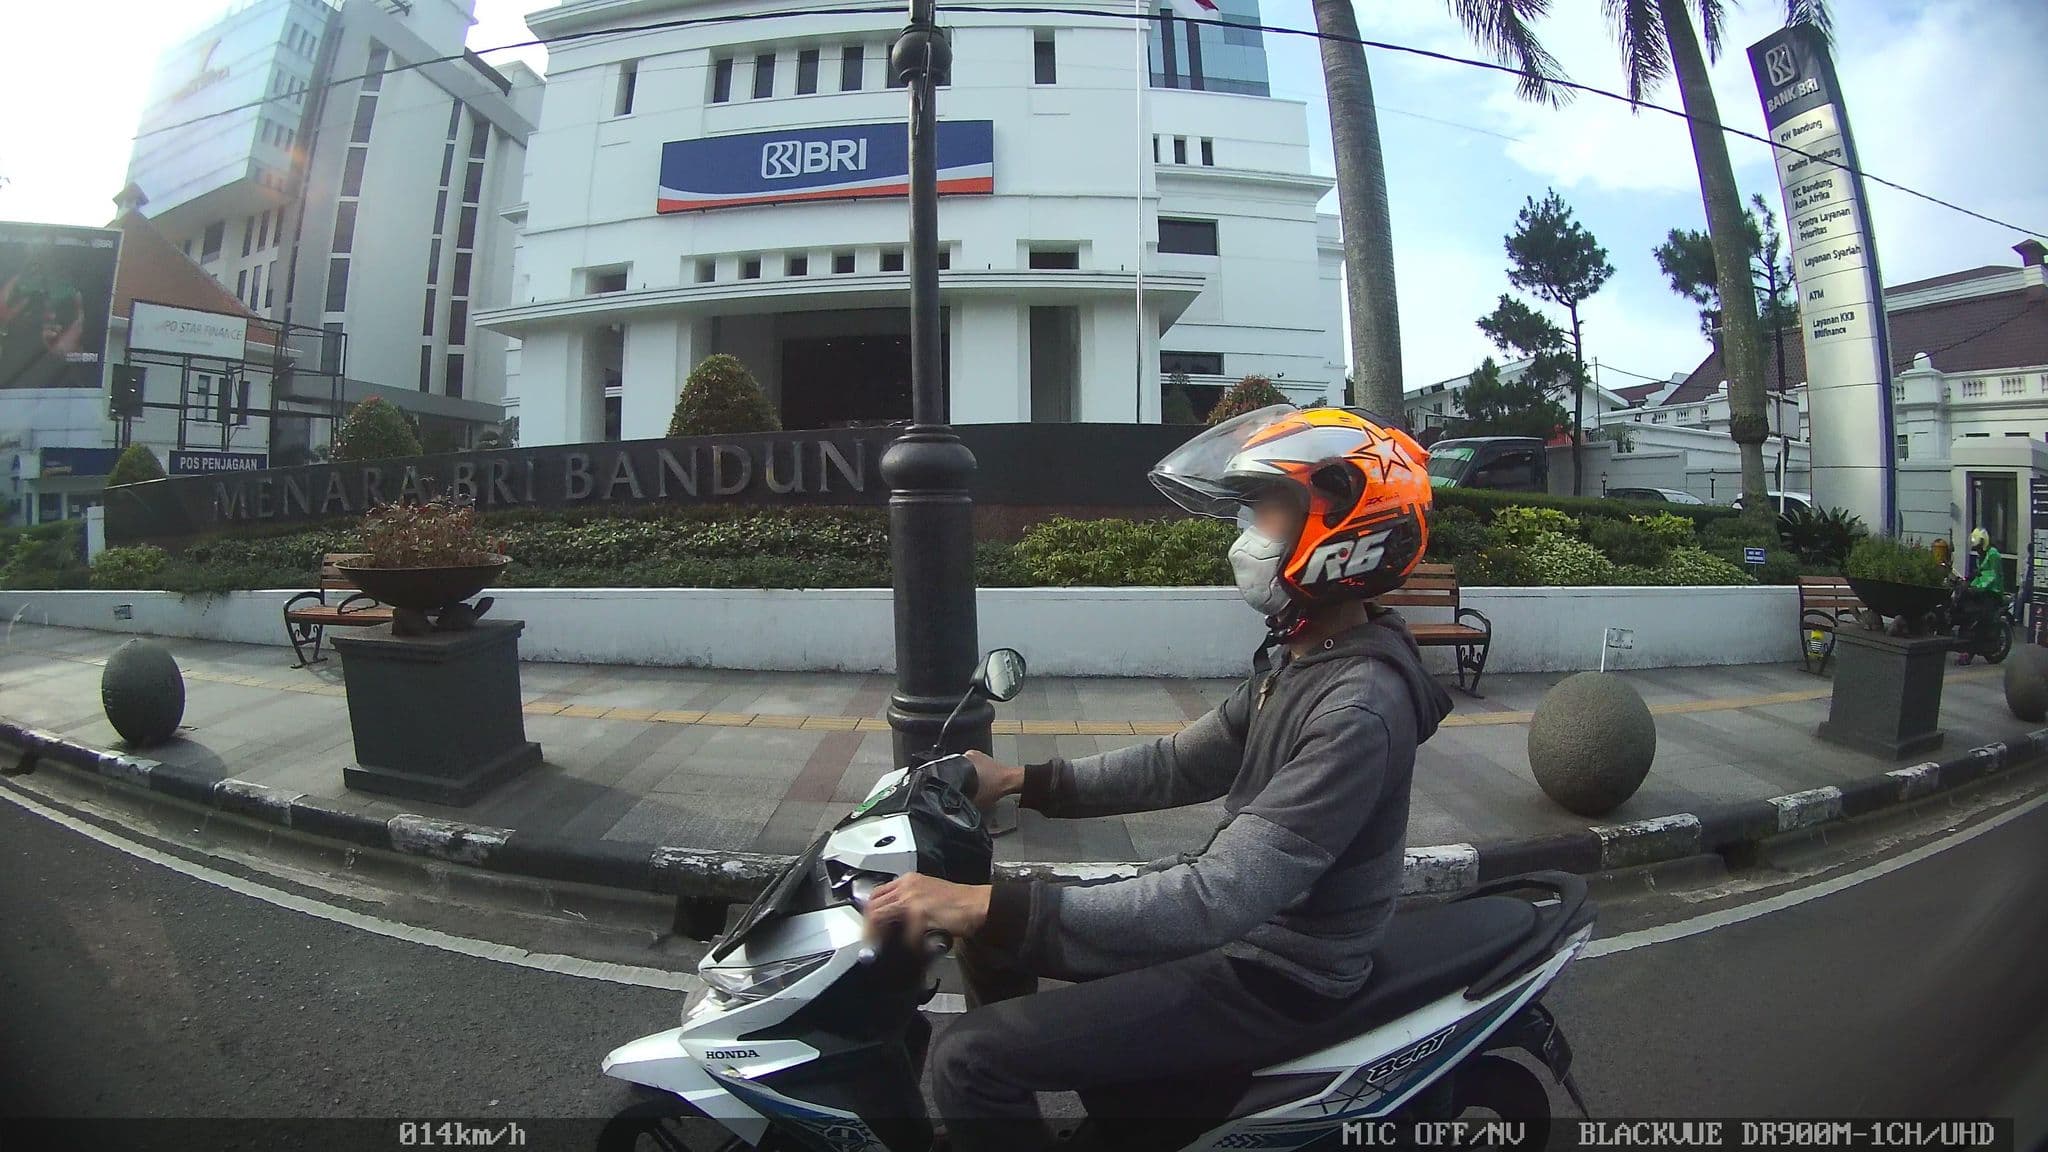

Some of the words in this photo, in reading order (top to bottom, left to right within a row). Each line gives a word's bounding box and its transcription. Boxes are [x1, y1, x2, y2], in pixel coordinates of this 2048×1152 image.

[1767, 86, 1797, 113] BANK
[1797, 77, 1820, 97] BRI
[1792, 120, 1823, 137] Bandung
[803, 138, 867, 174] BRI
[1792, 188, 1802, 198] KC
[1802, 179, 1833, 194] Bandung
[1795, 200, 1808, 211] Asia
[1809, 191, 1830, 205] Afrika
[1798, 217, 1819, 229] Sentra
[1819, 208, 1851, 222] Layanan
[1800, 227, 1827, 240] Prioritas
[1804, 252, 1832, 267] Layanan
[1832, 245, 1862, 260] Syariah
[1809, 289, 1825, 301] ATM
[1813, 315, 1840, 328] Layanan
[1840, 311, 1855, 322] KKB
[180, 456, 200, 469] POS
[202, 458, 258, 471] PENJAGAAN
[213, 465, 427, 520] MENARA
[451, 455, 537, 505] BRI
[563, 440, 867, 501] BANDUN
[1300, 529, 1393, 586] R6
[705, 1049, 761, 1059] HONDA
